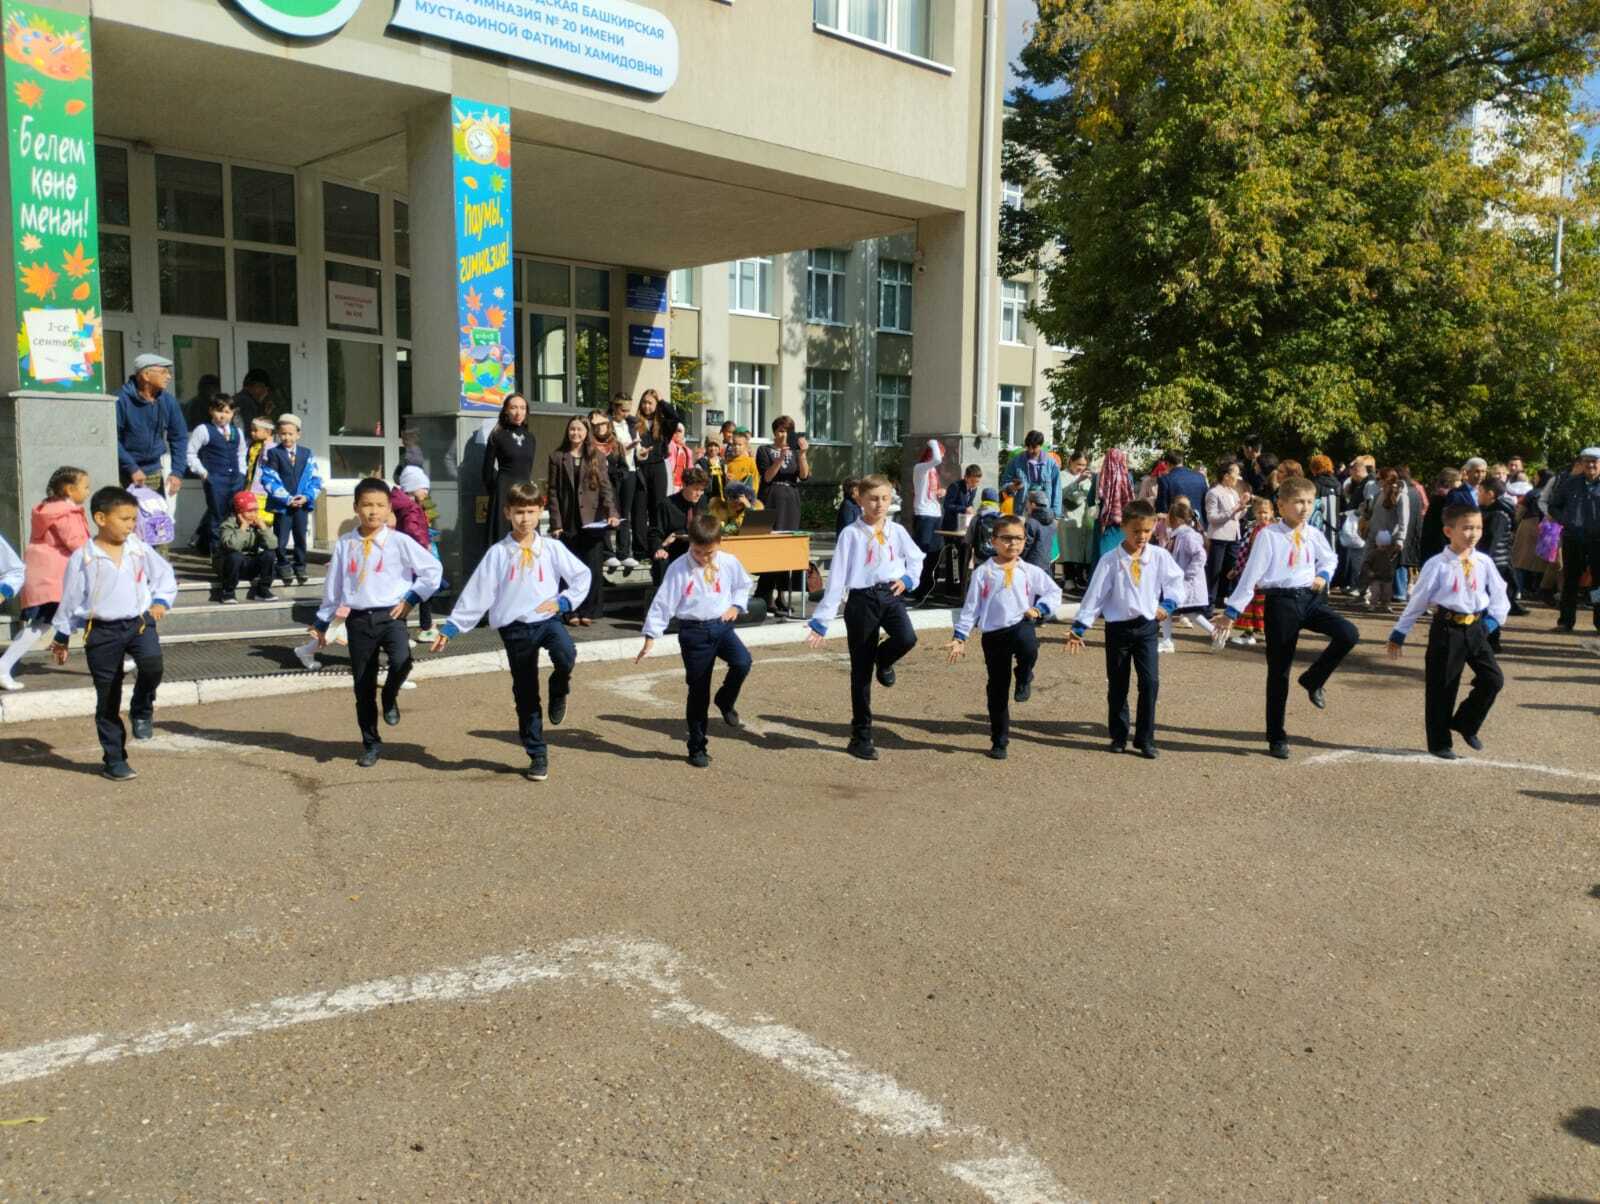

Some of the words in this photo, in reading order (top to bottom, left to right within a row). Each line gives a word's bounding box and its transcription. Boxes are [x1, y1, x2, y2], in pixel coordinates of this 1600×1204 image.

[416, 0, 518, 37] МУСТАФИНОЙ
[522, 28, 581, 54] ФАТИМЫ
[585, 45, 663, 77] ХАМИДОВНЫ
[465, 0, 541, 21] ИМНАЗИЯ
[546, 14, 558, 26] №
[562, 19, 577, 32] 20
[580, 24, 625, 47] ИМЕНИ
[582, 5, 664, 40] БАШКИРСКАЯ
[20, 114, 86, 166] Белем
